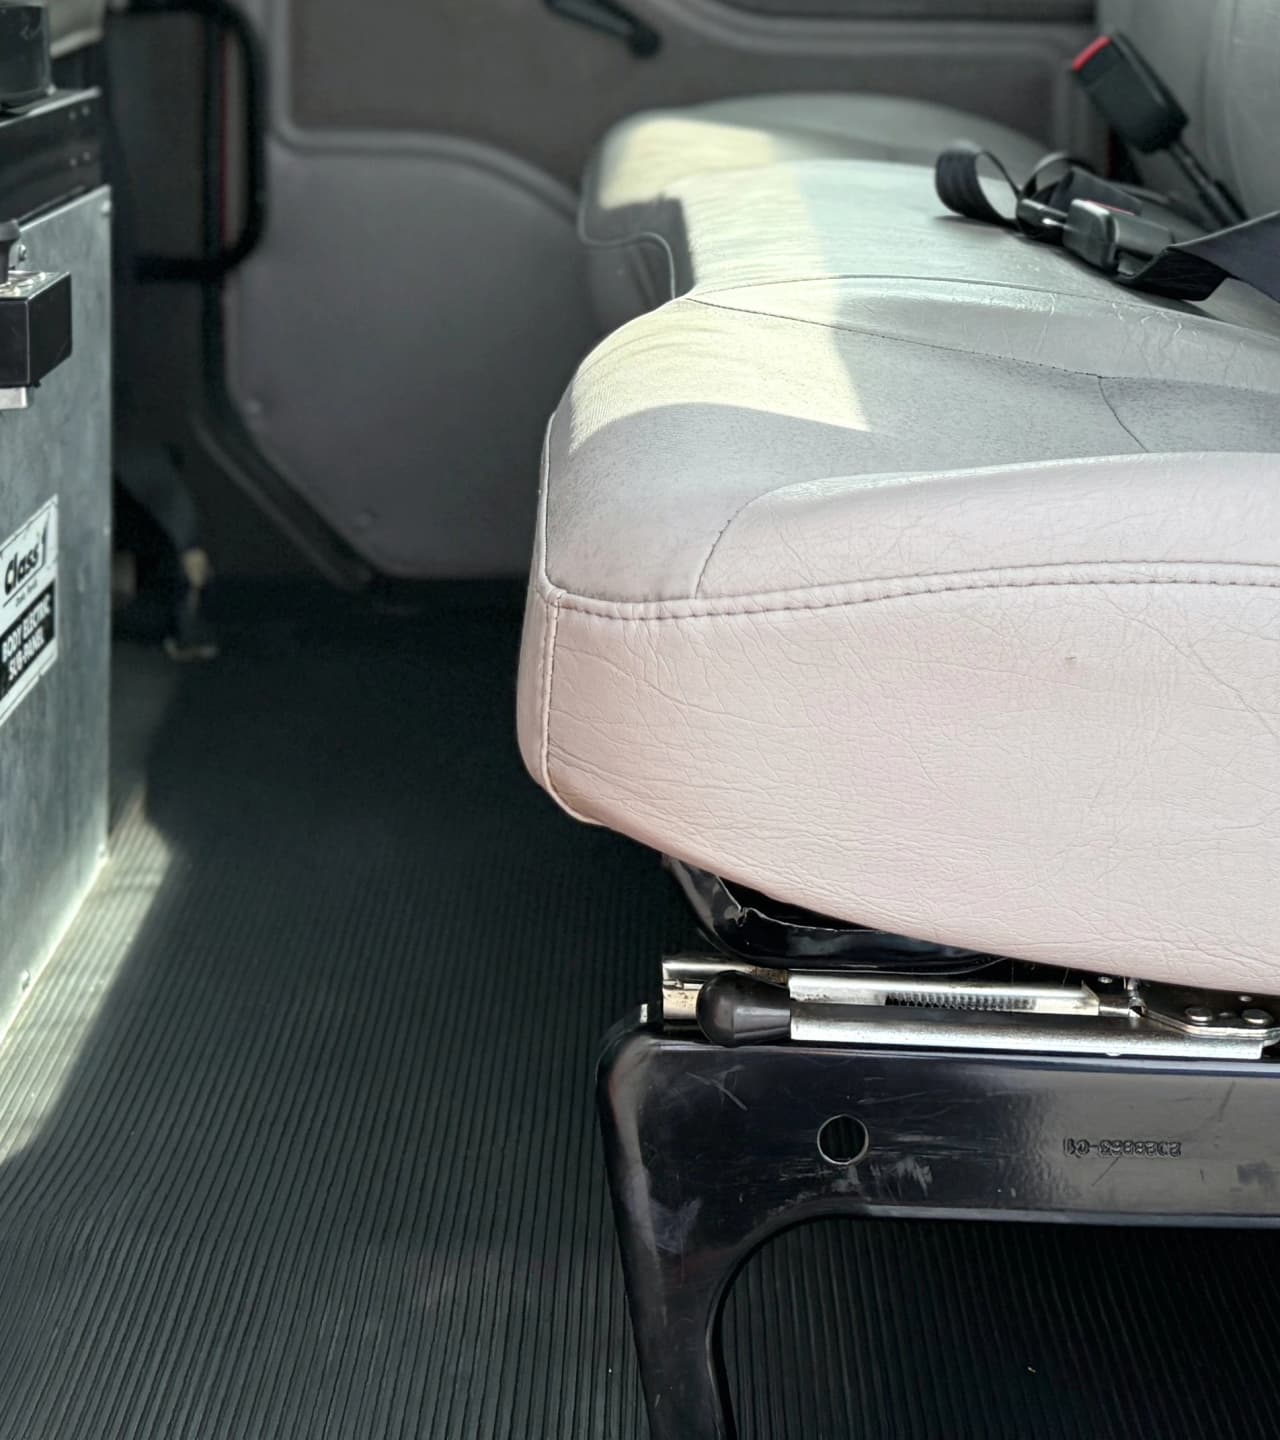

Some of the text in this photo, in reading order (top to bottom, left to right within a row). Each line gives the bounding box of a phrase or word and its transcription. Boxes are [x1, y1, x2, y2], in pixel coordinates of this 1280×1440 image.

[4, 543, 39, 596] Class
[1, 623, 22, 663] BODY
[22, 593, 51, 640] ELECTRIC
